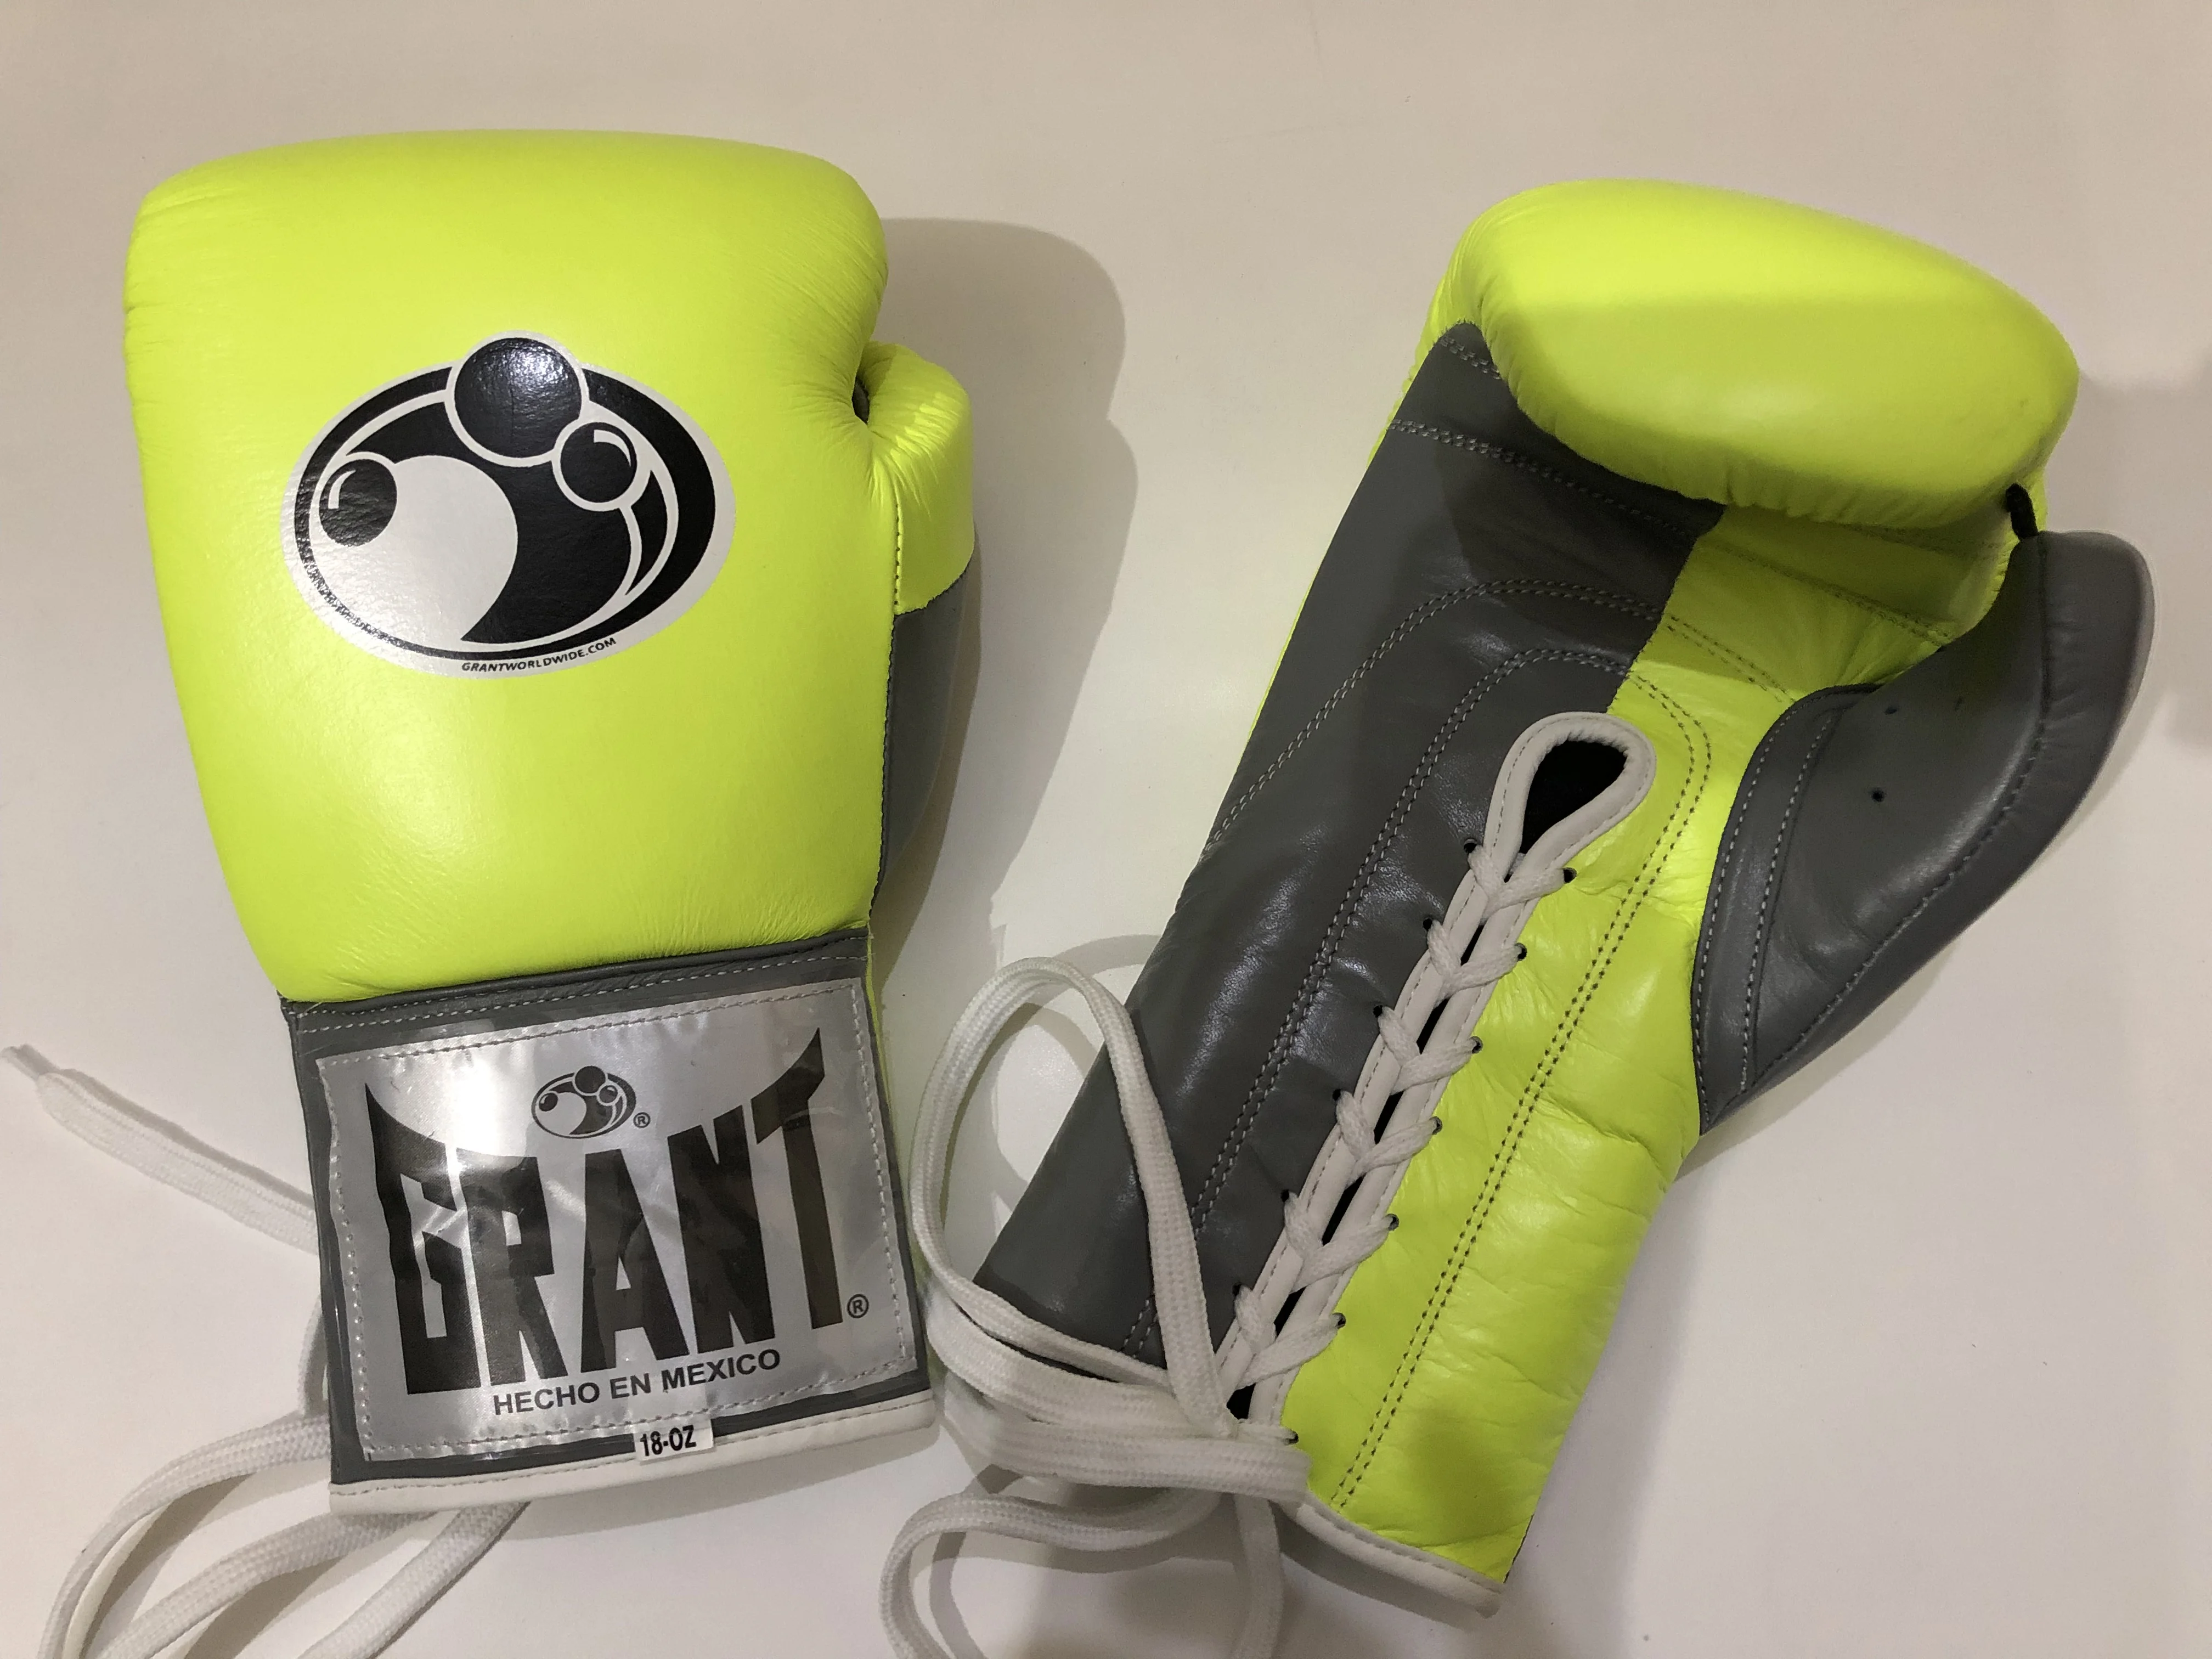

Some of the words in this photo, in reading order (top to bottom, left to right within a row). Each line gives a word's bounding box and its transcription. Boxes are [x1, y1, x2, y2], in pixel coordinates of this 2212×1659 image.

[461, 637, 616, 673] GRANTWORLDWIDE.COM
[364, 1027, 843, 1395] GRANT
[493, 1382, 600, 1415] HECHO
[609, 1373, 652, 1398] EN
[661, 1348, 781, 1390] MEXICO
[639, 1425, 697, 1457] 18-OZ
